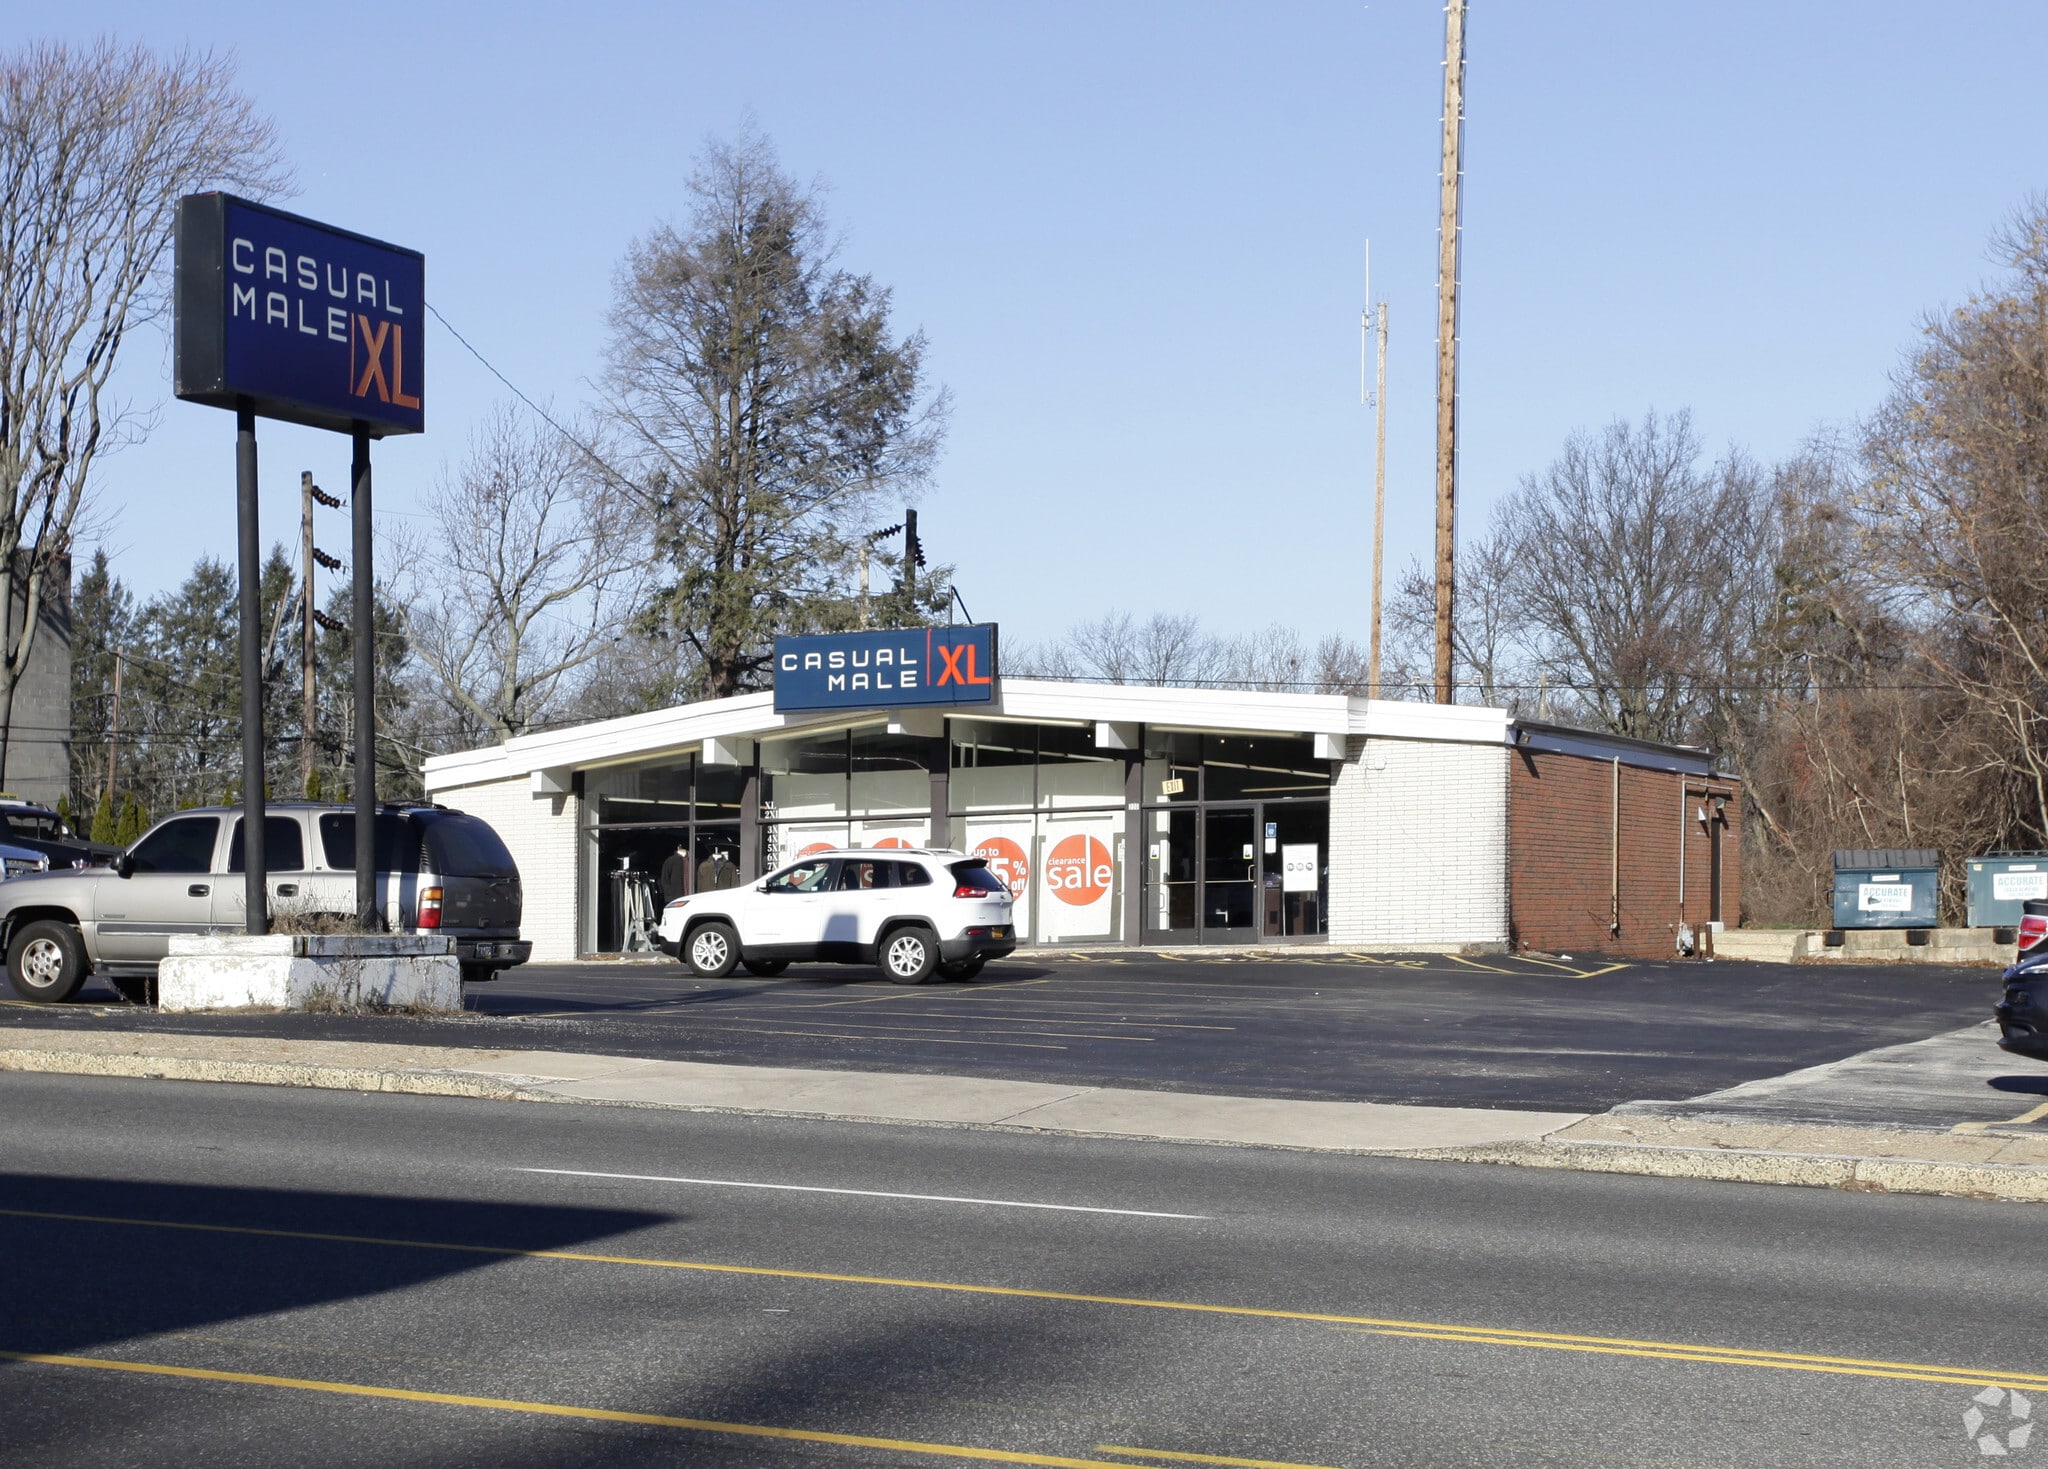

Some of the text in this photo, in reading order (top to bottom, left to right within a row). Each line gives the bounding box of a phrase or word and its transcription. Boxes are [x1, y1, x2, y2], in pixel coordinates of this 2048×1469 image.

[232, 237, 403, 315] CASUAL
[233, 282, 348, 343] MALE
[355, 313, 420, 410] XL
[781, 647, 918, 671] CASUAL
[937, 644, 992, 687] XL
[828, 670, 918, 691] MALE
[765, 801, 777, 810] XL
[767, 824, 779, 834] 3X
[767, 834, 779, 843] 4X
[767, 843, 779, 852] 5X
[973, 847, 1000, 858] up to
[766, 852, 779, 861] 6X
[1047, 834, 1112, 890] sale
[1048, 857, 1086, 866] clearance
[767, 861, 779, 871] 7X
[987, 857, 1010, 889] 5
[1011, 878, 1026, 891] off
[1998, 875, 2044, 886] ACCURATE
[1863, 887, 1908, 897] ACCURATE
